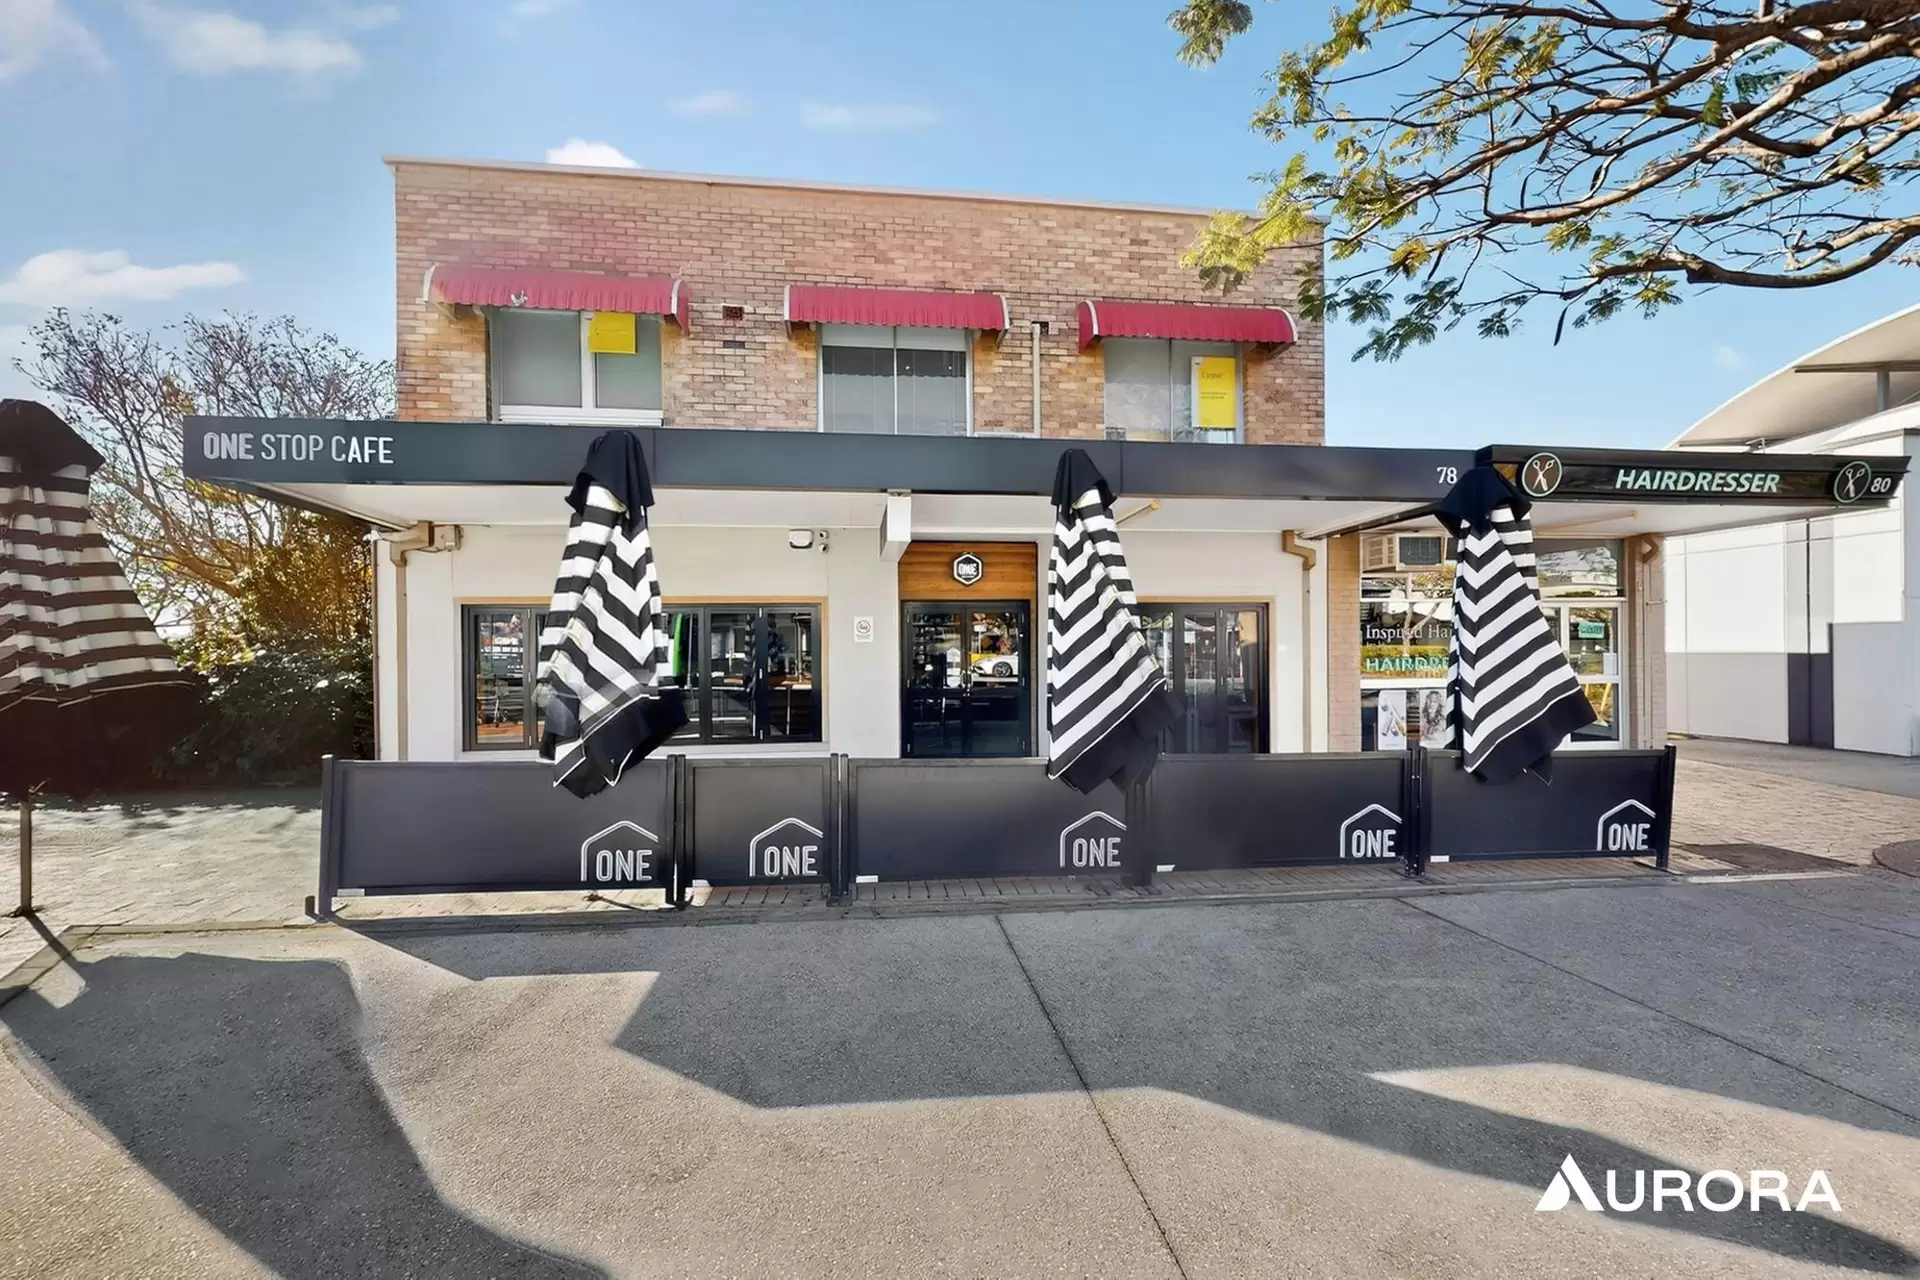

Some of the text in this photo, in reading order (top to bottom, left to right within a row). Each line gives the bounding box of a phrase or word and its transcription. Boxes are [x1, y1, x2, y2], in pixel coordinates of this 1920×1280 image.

[203, 431, 395, 464] ONE STOP CAFE
[1436, 466, 1458, 484] 78
[1615, 468, 1780, 493] HAIRDRESSER
[1870, 477, 1892, 493] 80
[1366, 624, 1423, 643] Inspid
[1351, 829, 1397, 858] ONE
[1607, 823, 1651, 851] ONE
[595, 849, 653, 882] ONE
[764, 845, 819, 877] ONE
[1072, 837, 1122, 868] ONE
